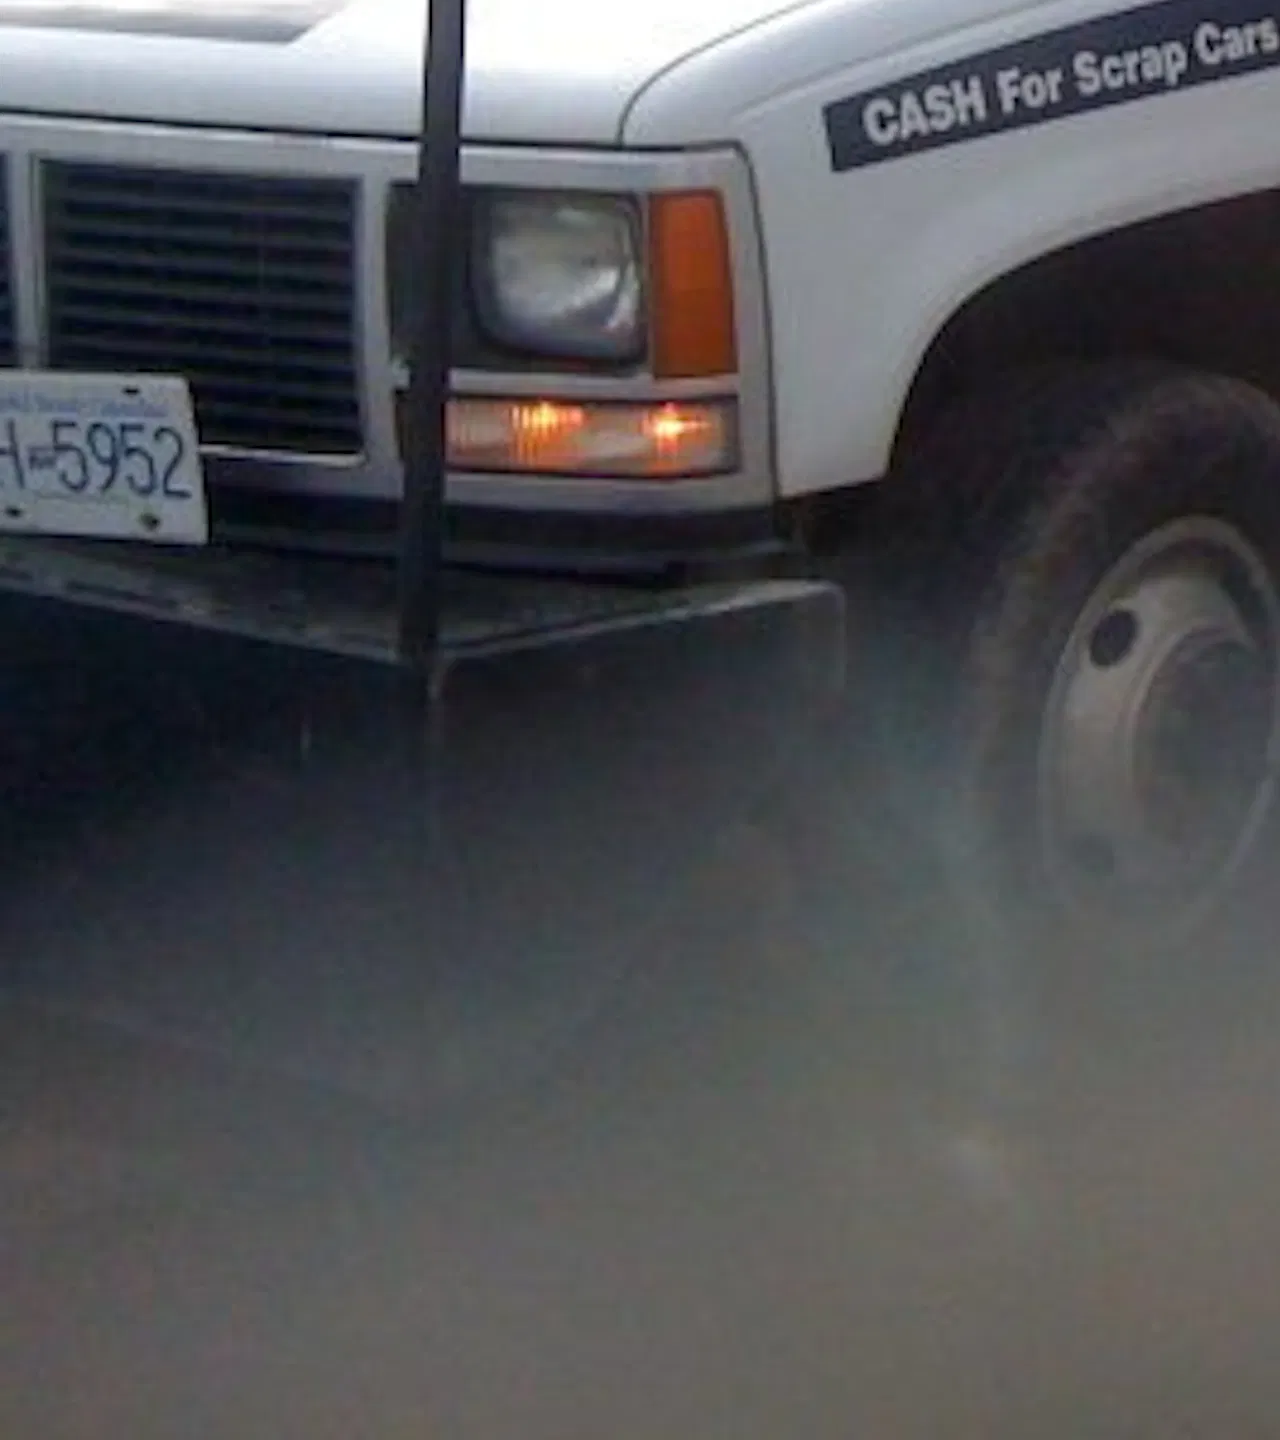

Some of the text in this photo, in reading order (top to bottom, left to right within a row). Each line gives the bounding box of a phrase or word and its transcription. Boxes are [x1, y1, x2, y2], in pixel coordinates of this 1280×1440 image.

[861, 15, 1280, 147] CASH For Scrap Cars
